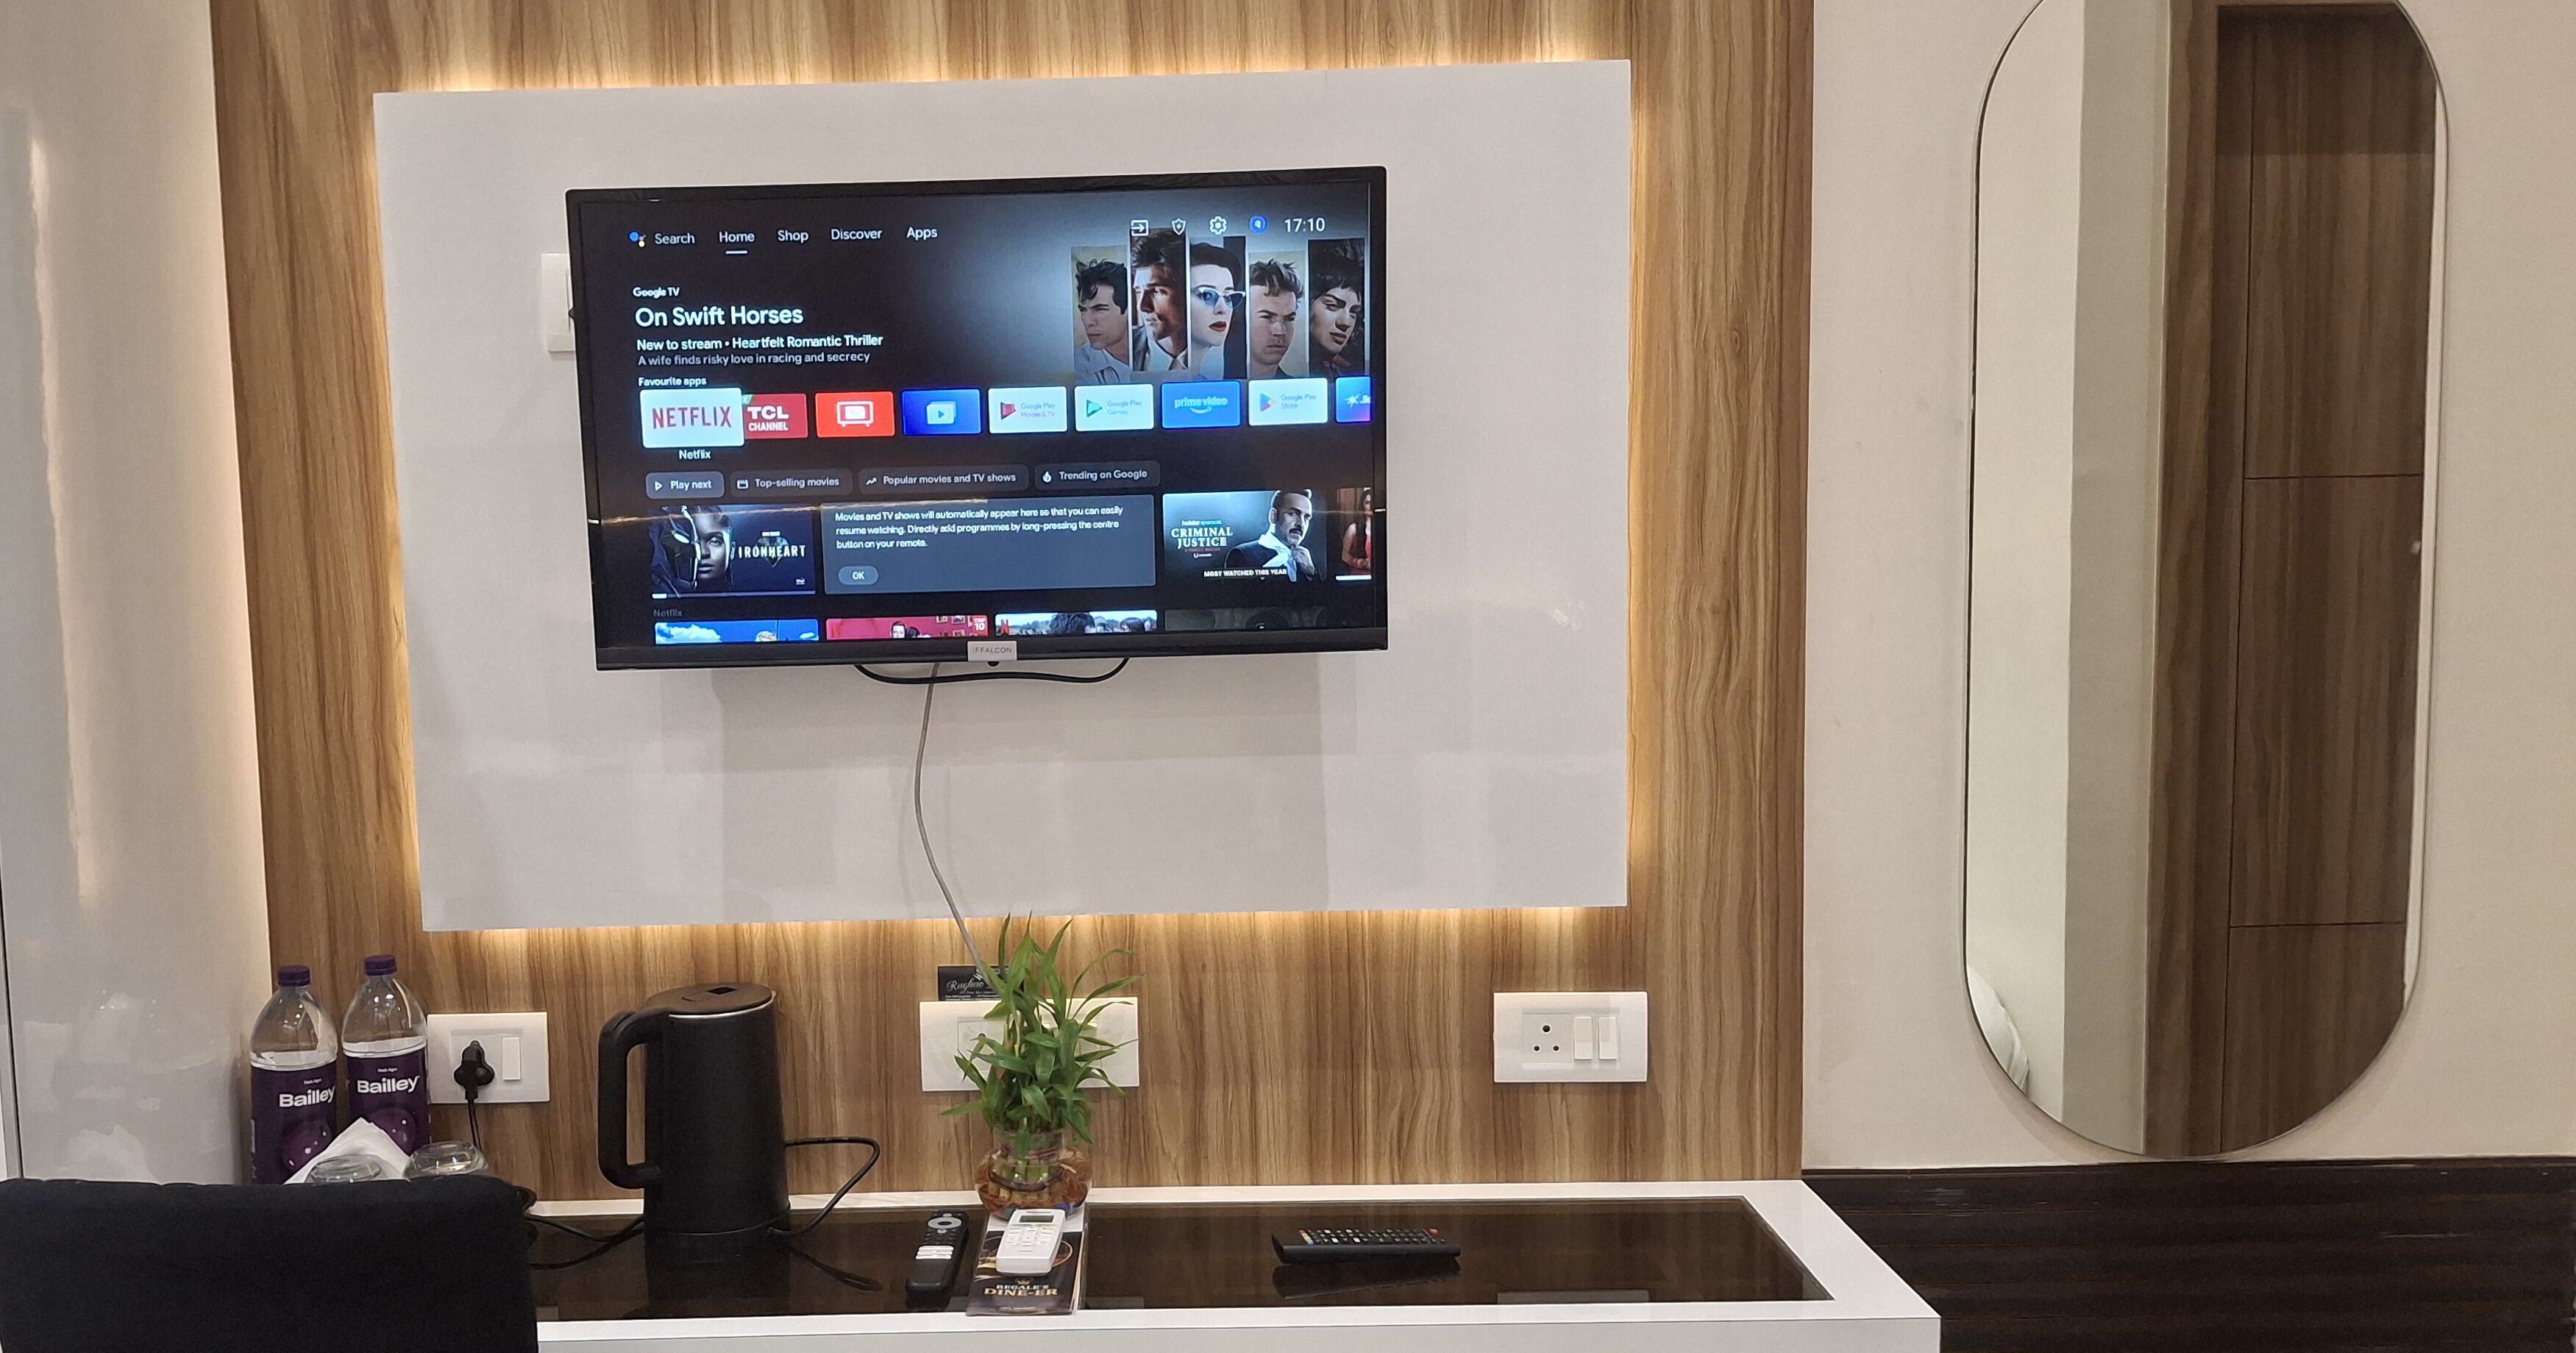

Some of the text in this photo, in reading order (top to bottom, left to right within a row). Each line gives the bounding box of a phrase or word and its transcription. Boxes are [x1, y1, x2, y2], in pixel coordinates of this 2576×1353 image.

[1284, 218, 1326, 232] 17:10
[655, 232, 695, 244] Search
[719, 231, 755, 243] Home
[778, 230, 809, 244] Shop
[831, 228, 883, 241] Discover
[906, 227, 938, 241] Apps
[633, 287, 680, 299] Google TV
[636, 305, 803, 327] On Swift Horses
[636, 334, 883, 350] New to stream Heartfelt Romantic Thriller
[638, 352, 870, 366] A wife finds risky love in racing and secrecy
[638, 376, 707, 387] Favourite apps
[1107, 399, 1142, 408] Google Play
[1175, 395, 1228, 408] prime video
[1281, 394, 1316, 402] Google Play
[747, 405, 789, 419] TCL
[1020, 402, 1055, 411] Google Play
[652, 406, 732, 429] NETFLIX
[749, 421, 789, 431] CHANNEL
[679, 450, 711, 459] Netflix
[883, 473, 1016, 486] Popular movies and TV shows
[1059, 471, 1097, 481] Trending
[1113, 469, 1148, 480] Google
[670, 480, 712, 491] Play next
[755, 477, 839, 489] Top-selling movies
[836, 512, 864, 521] Movies
[866, 512, 881, 520] and
[883, 512, 894, 520] TV
[894, 511, 919, 520] shows
[920, 511, 934, 519] will
[936, 509, 989, 519] automatically
[990, 510, 1019, 519] appear
[1020, 508, 1038, 516] here
[1050, 507, 1067, 516] that
[1068, 508, 1084, 517] you
[1084, 507, 1100, 515] can
[1100, 505, 1123, 516] easily
[836, 520, 1119, 535] resume watching. Directly add programmes by long-pressing the centre
[1171, 526, 1233, 538] CRIMINAL
[836, 540, 864, 549] button
[876, 540, 894, 550] your
[896, 539, 928, 547] remote.
[1177, 537, 1227, 549] JUSTICE
[739, 544, 805, 558] IRONHEART
[852, 571, 865, 580] OK
[653, 608, 683, 617] Netflix
[975, 622, 985, 631] 10
[357, 1076, 419, 1094] Bailley
[279, 1085, 336, 1107] Bailley
[984, 1288, 1058, 1296] DINE-ER
